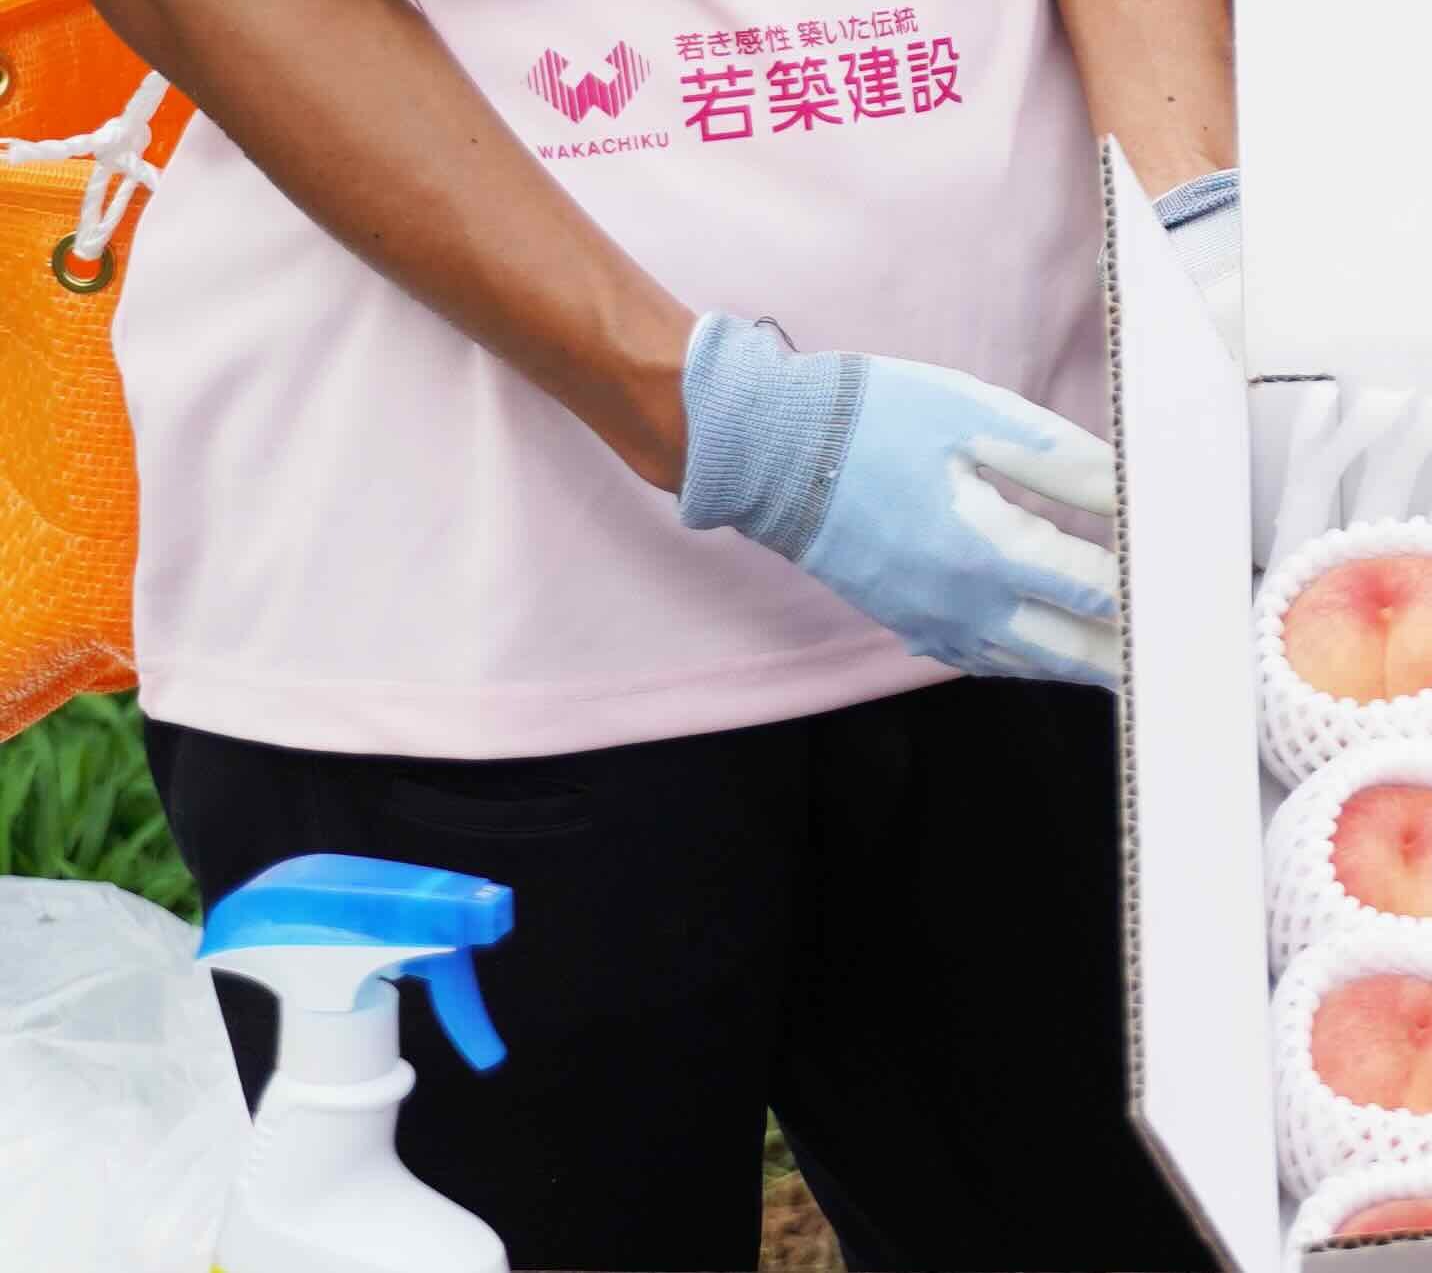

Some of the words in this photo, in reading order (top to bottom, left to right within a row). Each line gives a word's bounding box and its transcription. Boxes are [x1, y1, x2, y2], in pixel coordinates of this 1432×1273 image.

[675, 21, 796, 61] 若き感性
[798, 7, 920, 49] 築いた伝統
[680, 35, 963, 144] 若築建設
[538, 132, 671, 160] WAKACHIKU
